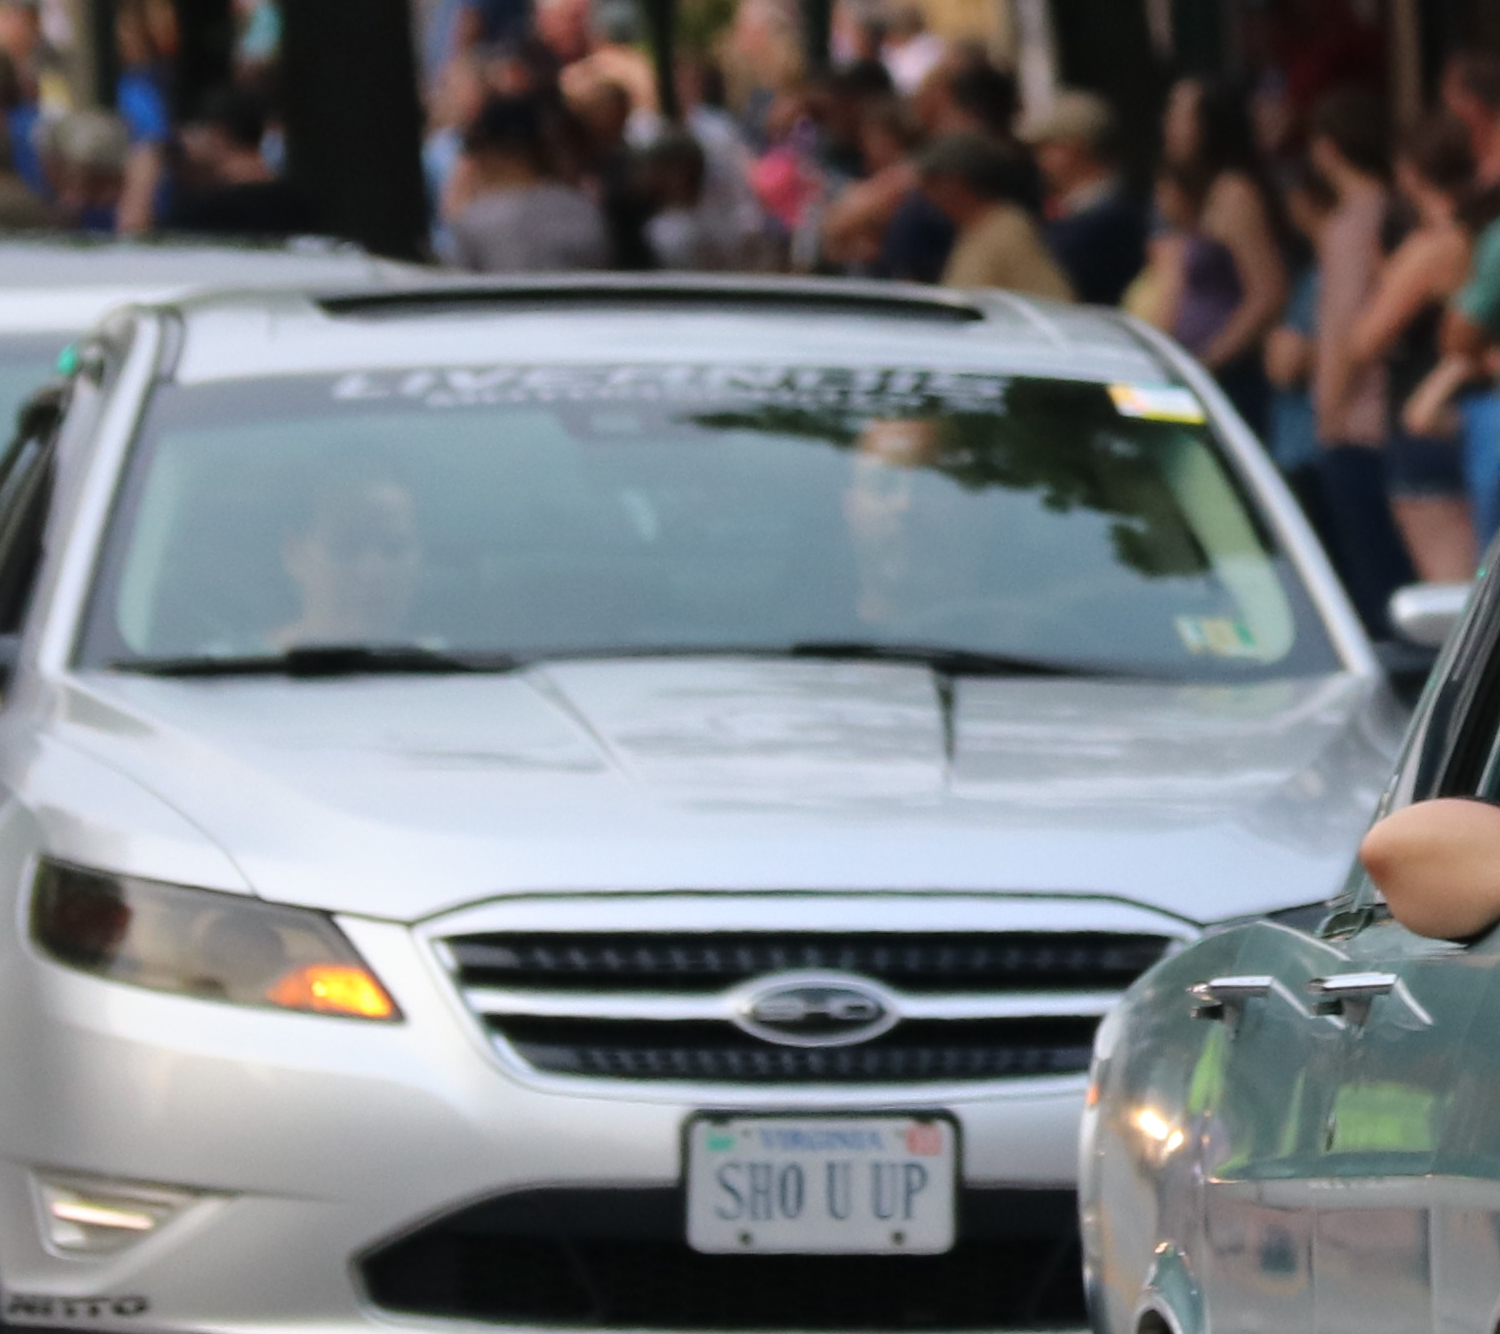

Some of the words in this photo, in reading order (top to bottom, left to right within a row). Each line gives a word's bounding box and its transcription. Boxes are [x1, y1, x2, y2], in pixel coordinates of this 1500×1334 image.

[714, 1160, 806, 1221] SHO
[825, 1160, 853, 1221] U
[870, 1160, 930, 1221] UP
